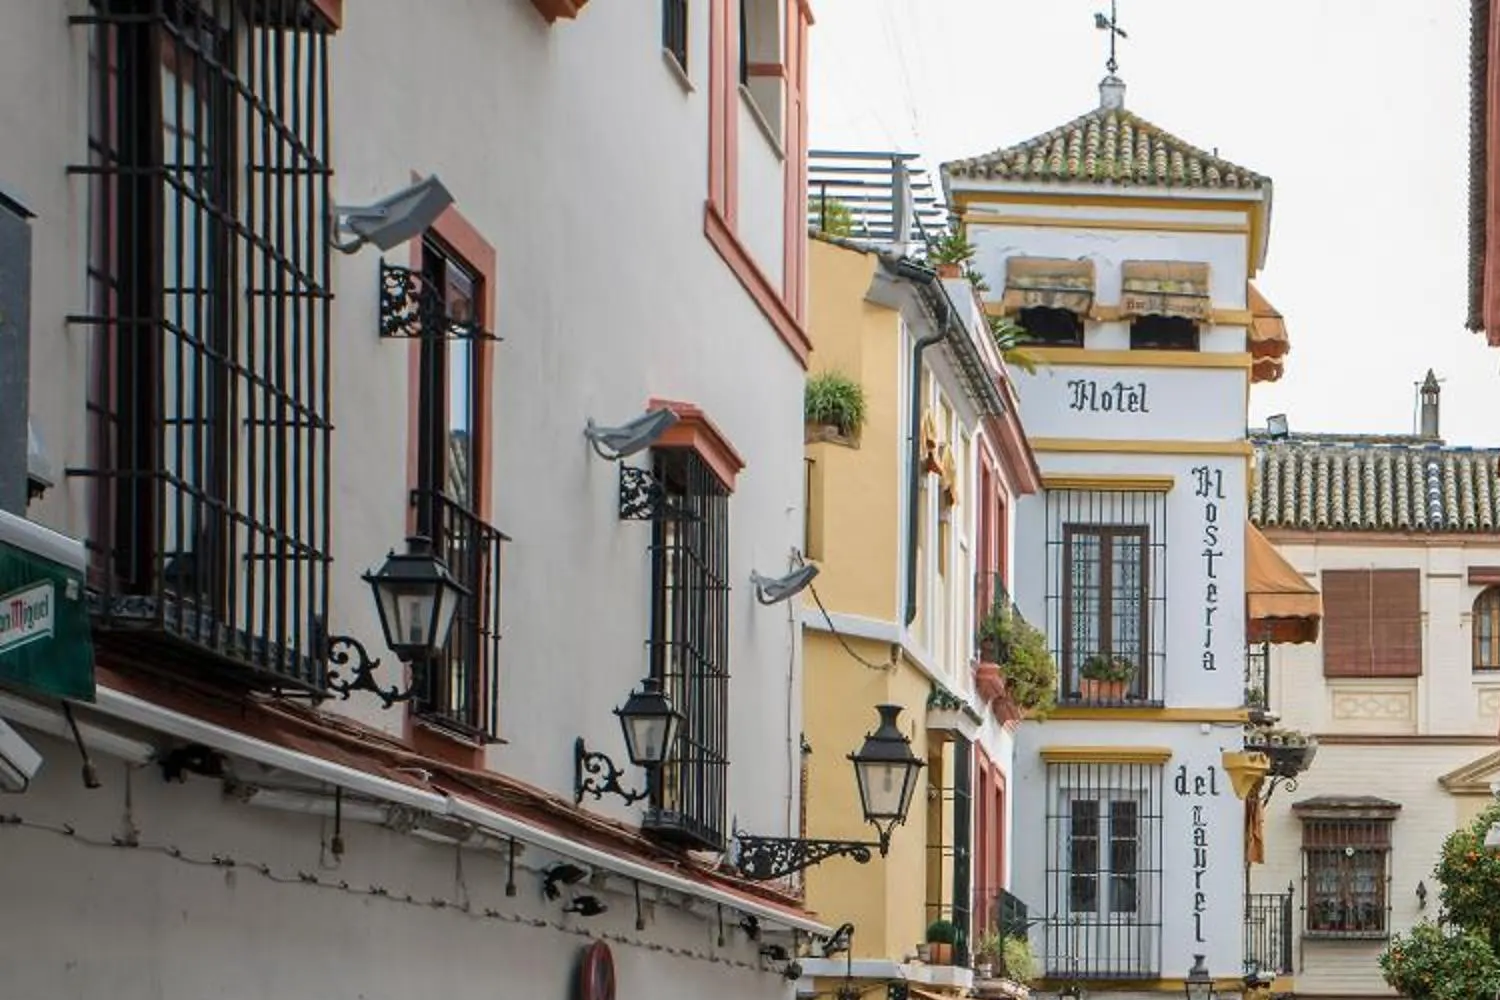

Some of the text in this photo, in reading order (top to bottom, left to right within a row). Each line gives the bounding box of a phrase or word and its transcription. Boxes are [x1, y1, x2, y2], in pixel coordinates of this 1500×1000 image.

[1067, 379, 1149, 413] Hotel
[1191, 465, 1226, 671] Hosteria
[1175, 765, 1221, 797] del
[1192, 805, 1209, 943] Laurel
